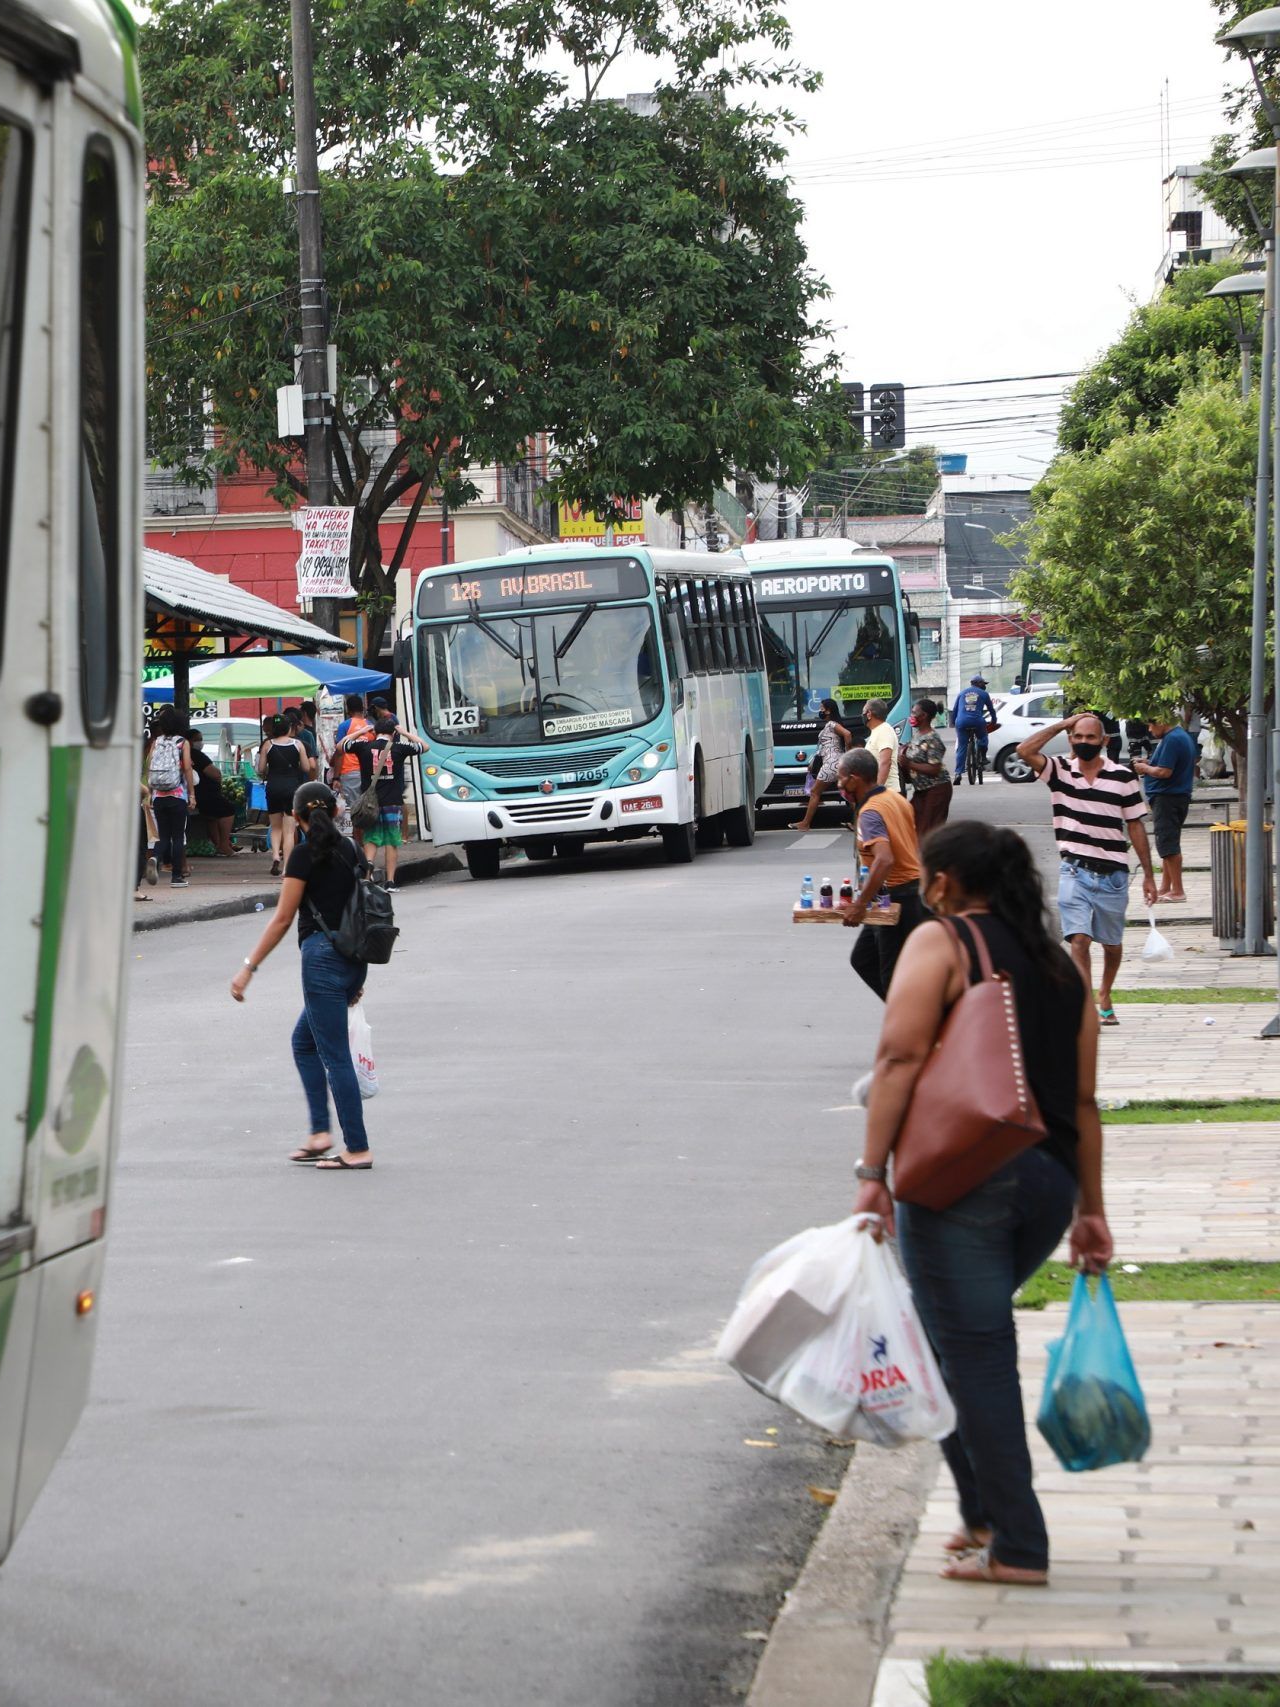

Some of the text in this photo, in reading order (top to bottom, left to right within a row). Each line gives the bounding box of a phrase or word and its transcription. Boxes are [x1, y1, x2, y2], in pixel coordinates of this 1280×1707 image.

[307, 509, 350, 520] DINHEIRO
[304, 521, 349, 531] NA HORA
[305, 539, 329, 549] TAXAS
[451, 571, 593, 601] 126 AV.BRASIL
[761, 573, 865, 596] AEROPORTO
[444, 709, 477, 726] 126
[608, 710, 630, 718] SOMENTE
[557, 724, 572, 733] COM
[573, 723, 588, 731] USO
[588, 721, 597, 729] DE
[780, 722, 817, 730] Marcopolo
